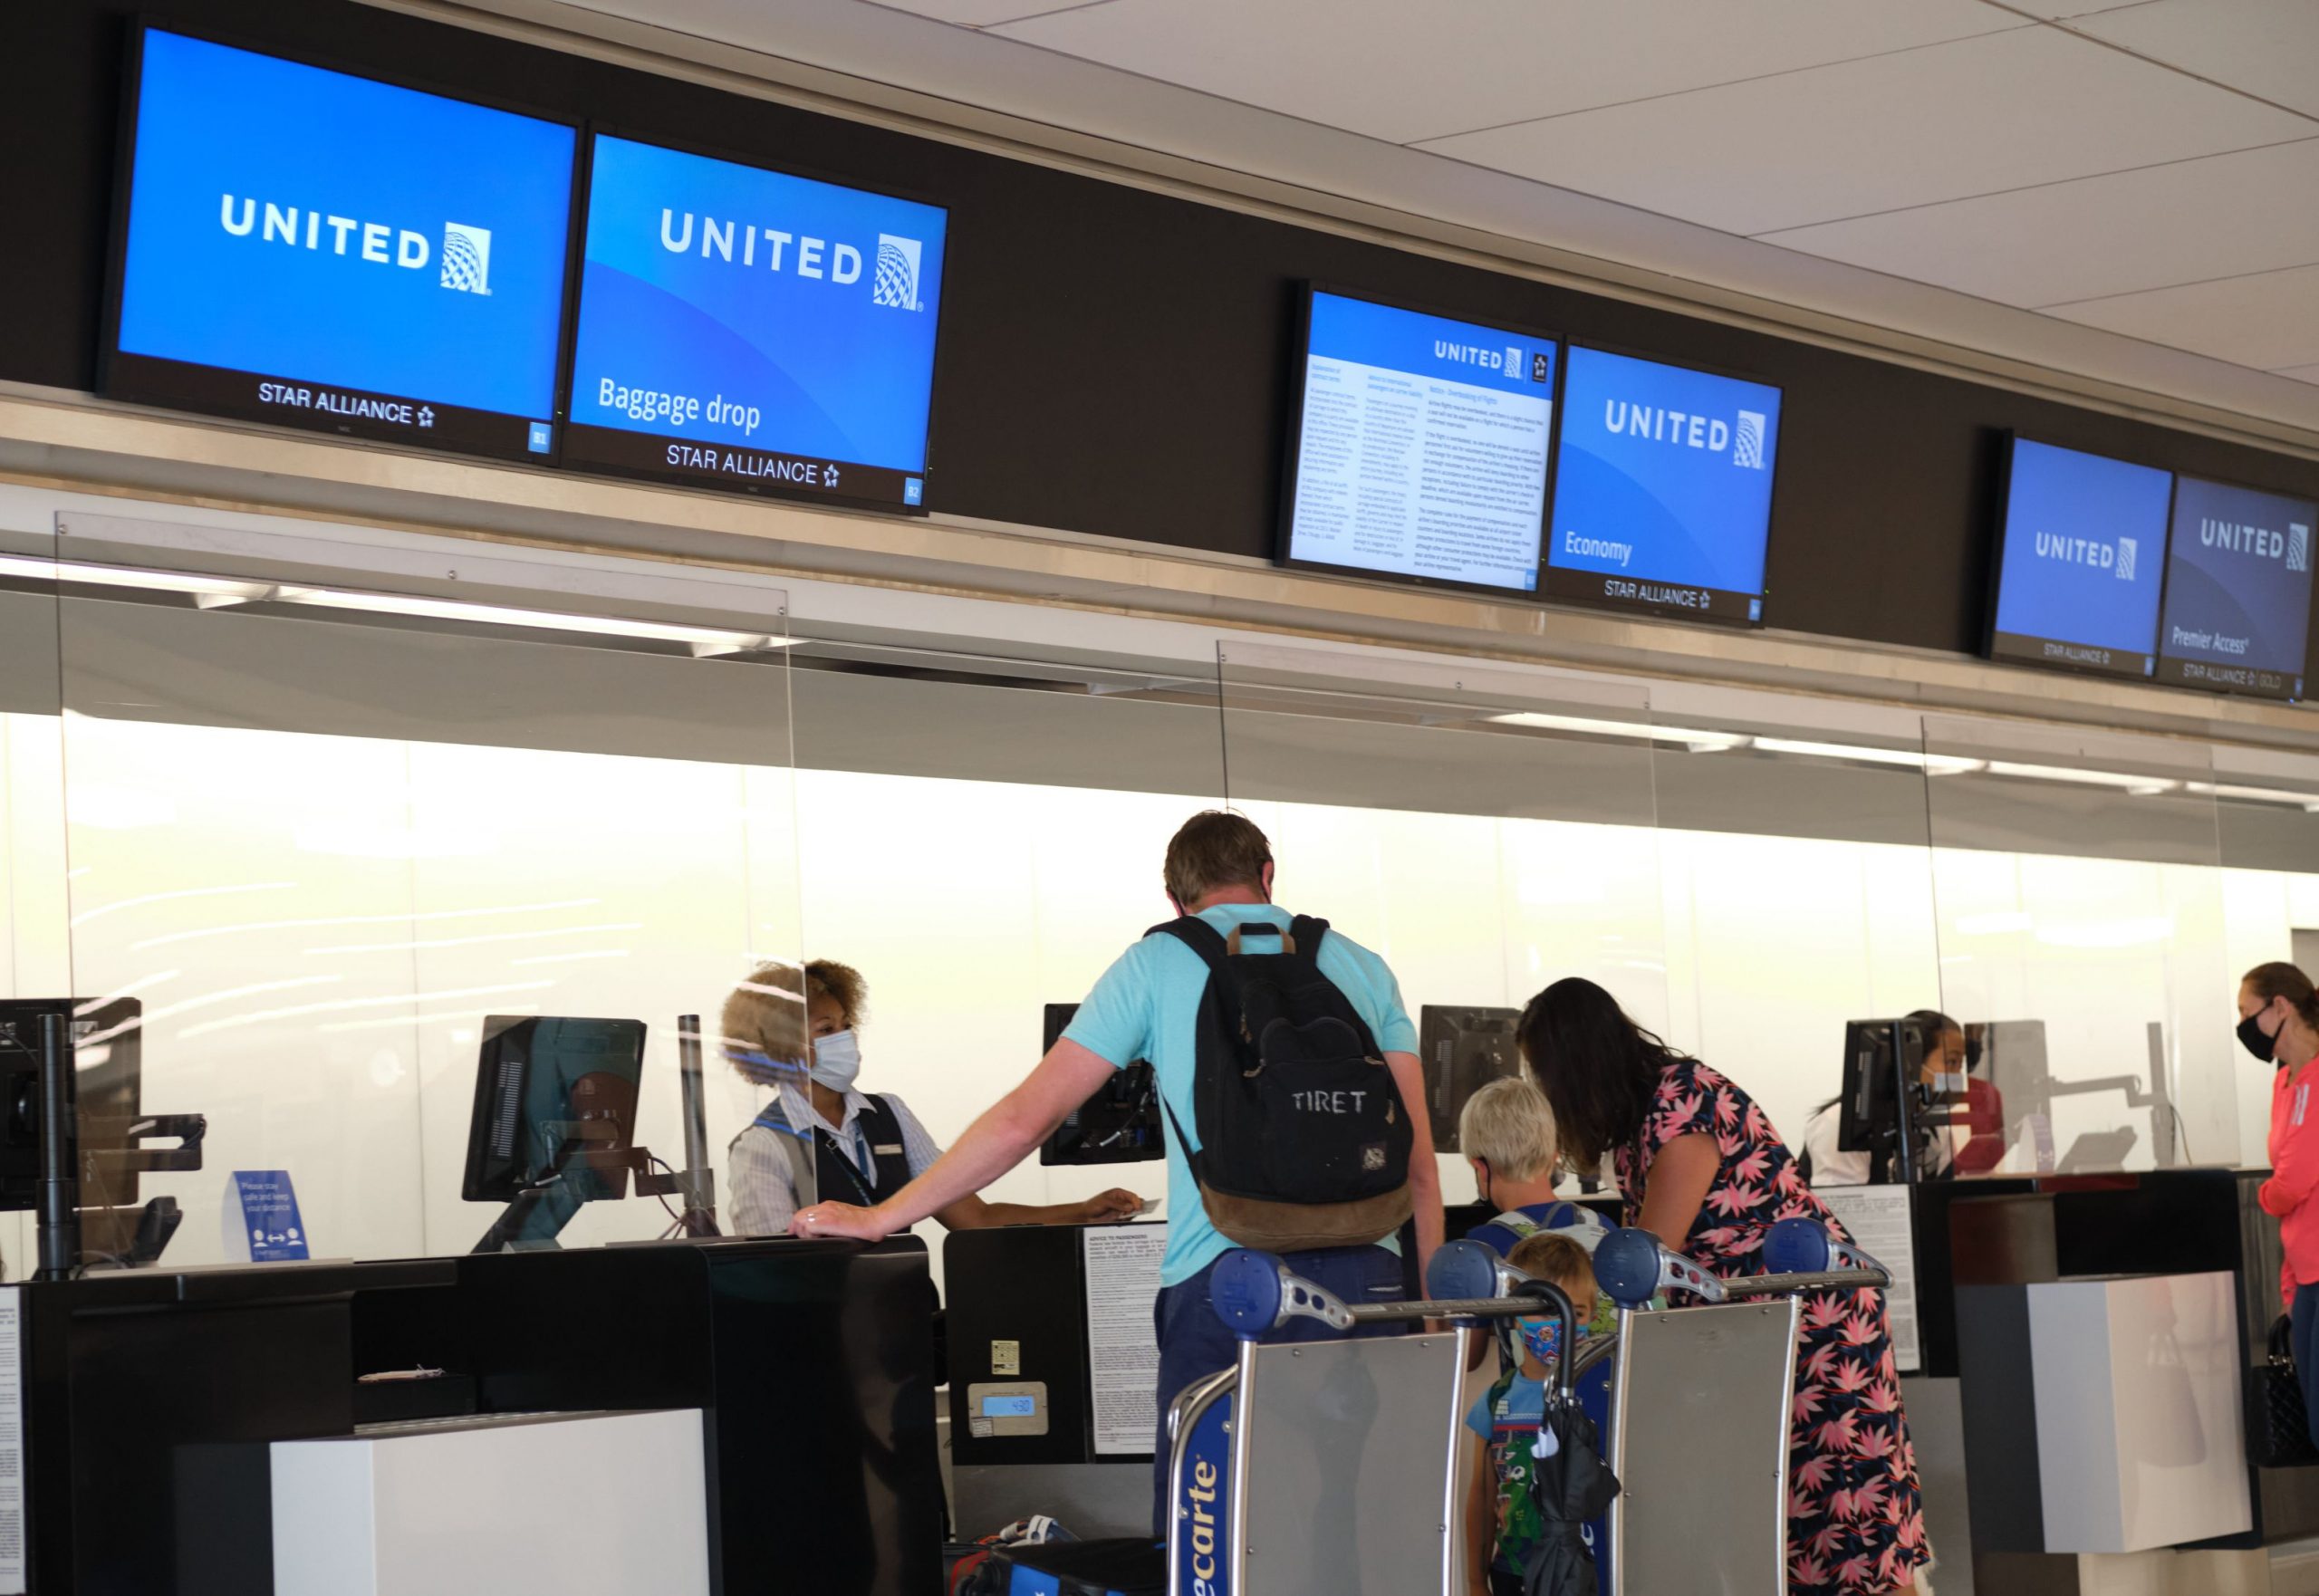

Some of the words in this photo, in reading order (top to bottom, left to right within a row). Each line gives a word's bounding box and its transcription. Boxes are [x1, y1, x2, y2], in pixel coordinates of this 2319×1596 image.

[220, 194, 430, 269] UNITED
[660, 208, 862, 284] UNITED
[1434, 340, 1502, 370] UNITED
[258, 382, 311, 408] STAR
[314, 391, 413, 424] ALLIANCE
[599, 377, 699, 426] Baggage
[706, 394, 760, 437] drop
[1605, 399, 1728, 452] UNITED
[667, 444, 717, 470] STAR
[722, 453, 818, 484] ALLIANCE
[908, 486, 919, 498] B2
[1564, 531, 1632, 567] Economy
[2035, 532, 2113, 568] UNITED
[2200, 518, 2284, 559] UNITED
[1604, 580, 1637, 599] STAR
[1638, 584, 1698, 608] ALLIANCE
[2044, 642, 2064, 658] STAR
[2065, 645, 2102, 664] ALLIANCE
[2172, 626, 2212, 649] Premier
[2183, 663, 2205, 678] STAR
[2206, 667, 2247, 686] ALLIANCE
[2259, 673, 2282, 690] GOLD
[1292, 1090, 1367, 1114] TIRET
